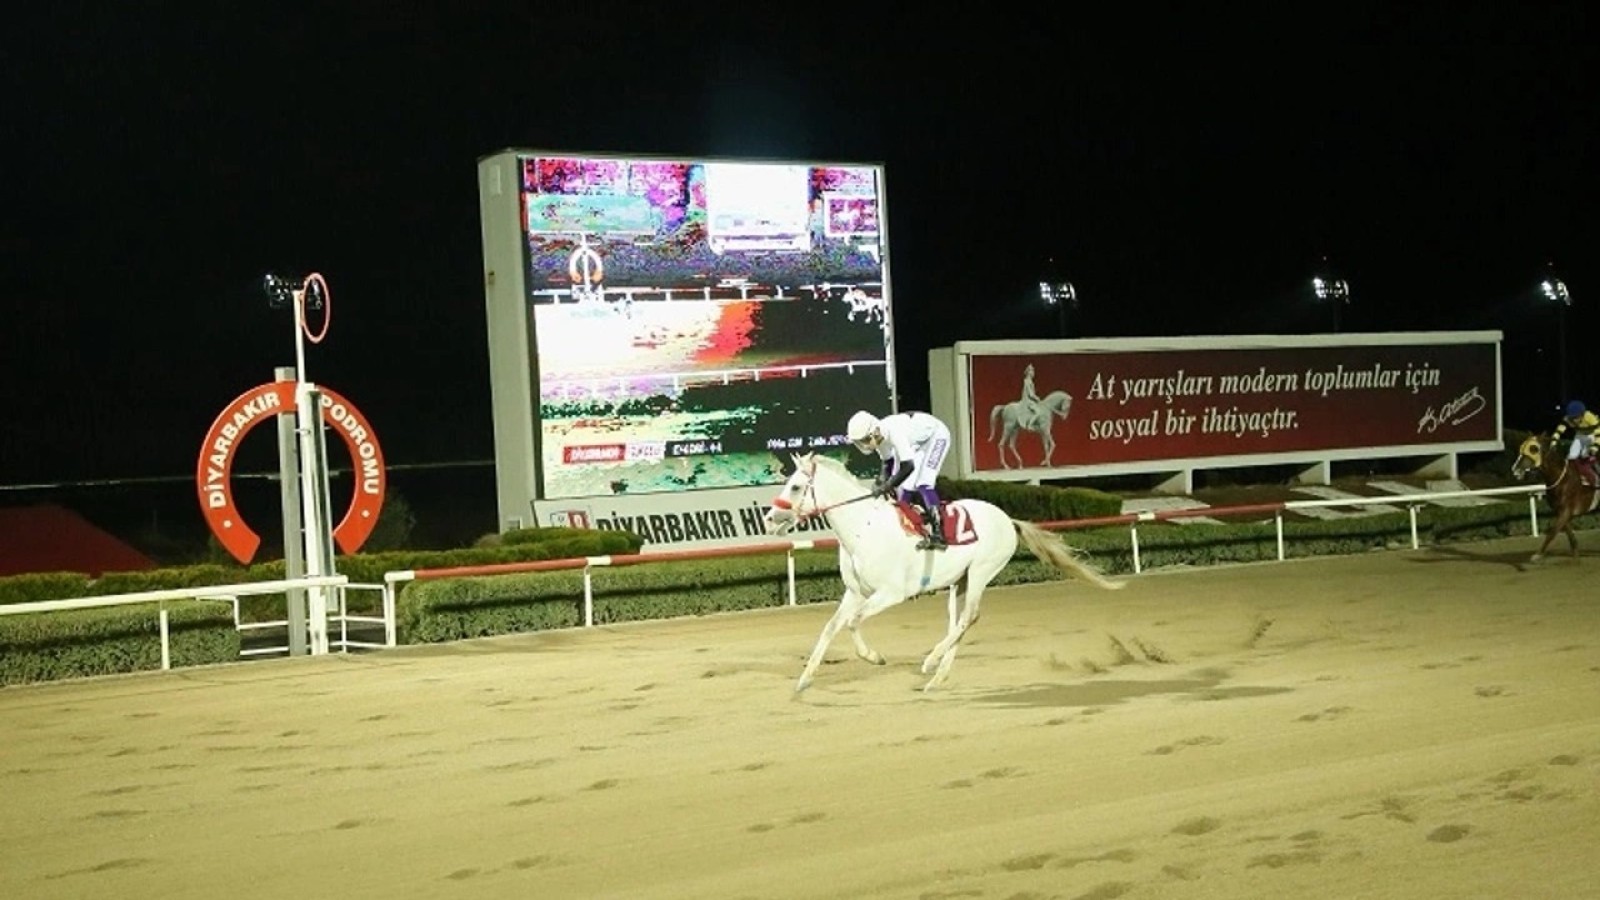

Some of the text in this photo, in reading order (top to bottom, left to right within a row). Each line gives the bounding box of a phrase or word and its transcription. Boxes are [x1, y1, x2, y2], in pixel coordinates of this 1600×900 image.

[1086, 362, 1440, 405] At yarışları modern toplumlar için
[1089, 406, 1299, 445] sosyal bir ihtiyaçtır.
[204, 391, 379, 509] DİYARBAKIR PODROMU
[945, 504, 976, 543] 2
